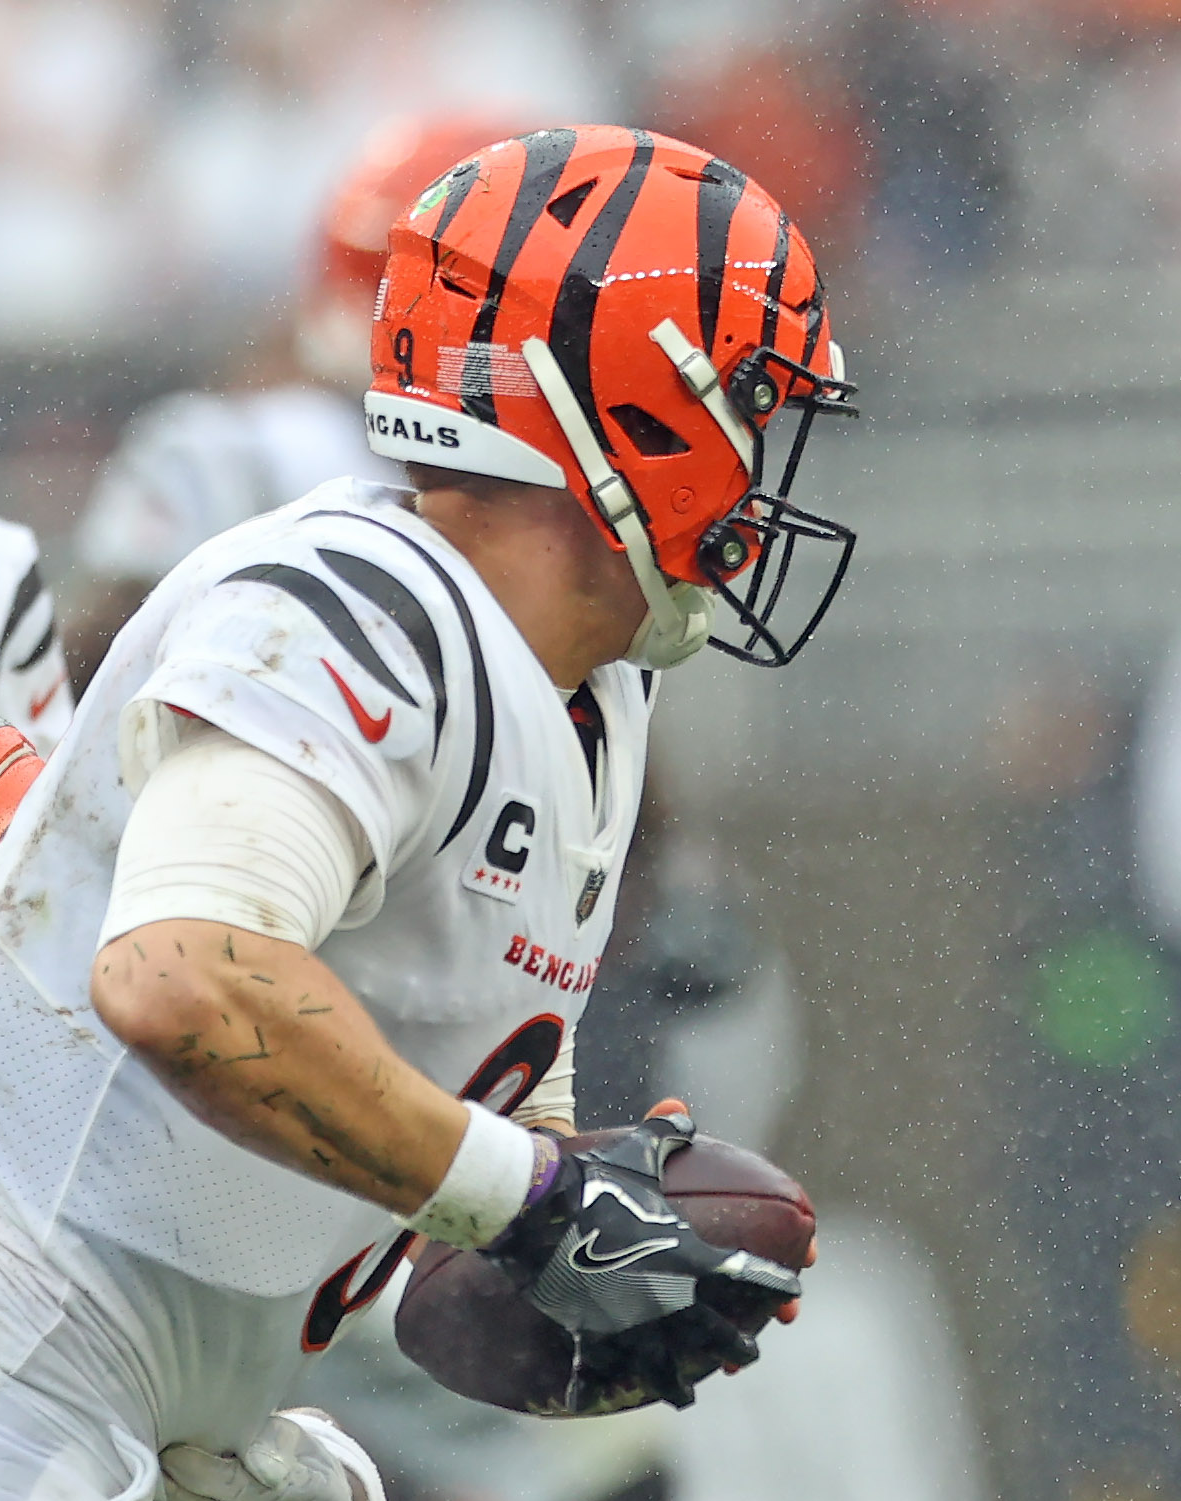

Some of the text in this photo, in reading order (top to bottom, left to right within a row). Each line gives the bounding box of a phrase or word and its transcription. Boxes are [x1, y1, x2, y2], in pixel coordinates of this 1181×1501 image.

[393, 328, 414, 390] 9
[485, 800, 536, 875] C
[503, 933, 603, 995] BENGAL
